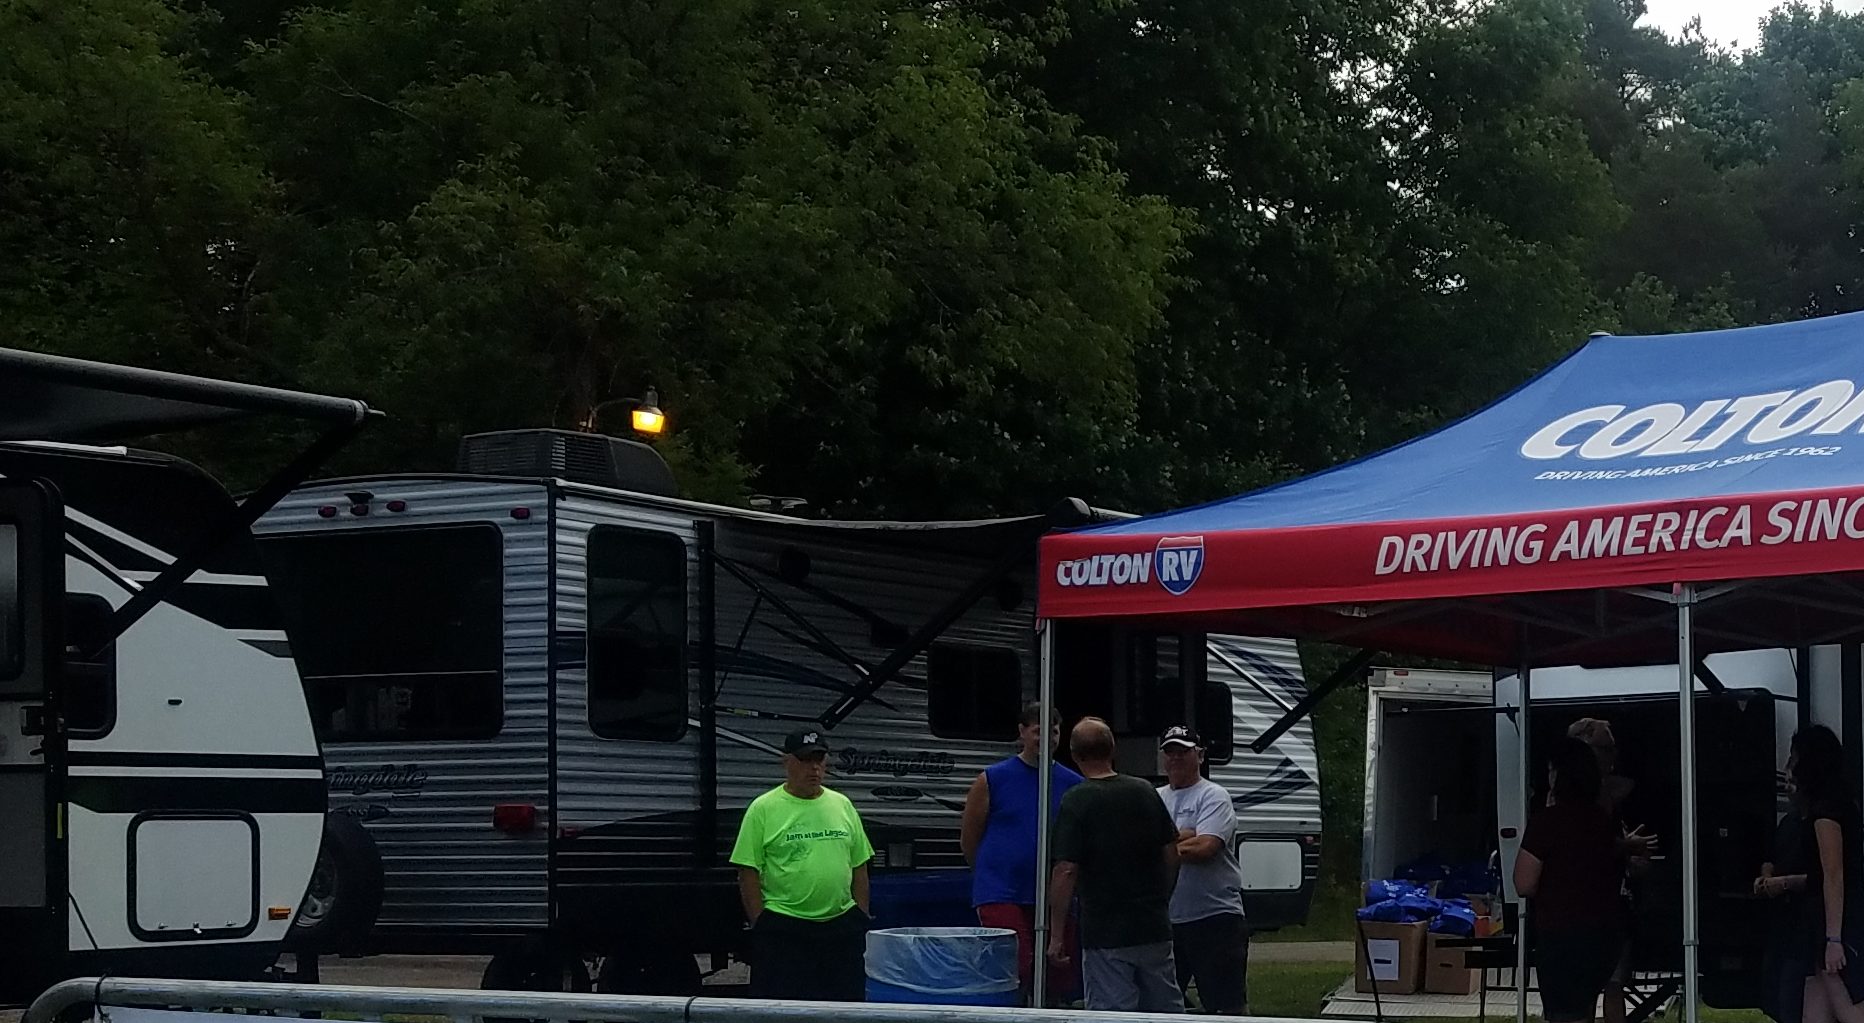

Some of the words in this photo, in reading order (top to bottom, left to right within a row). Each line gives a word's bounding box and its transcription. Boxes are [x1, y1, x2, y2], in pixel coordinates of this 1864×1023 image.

[1534, 471, 1622, 480] DRIVING
[1623, 460, 1719, 479] AMERICA
[1717, 448, 1781, 467] SINCE
[1782, 446, 1842, 457] 1962
[1375, 523, 1547, 576] DRIVING
[1550, 504, 1752, 562] AMERICA
[1056, 552, 1152, 586] COLTON
[1162, 550, 1199, 582] RV
